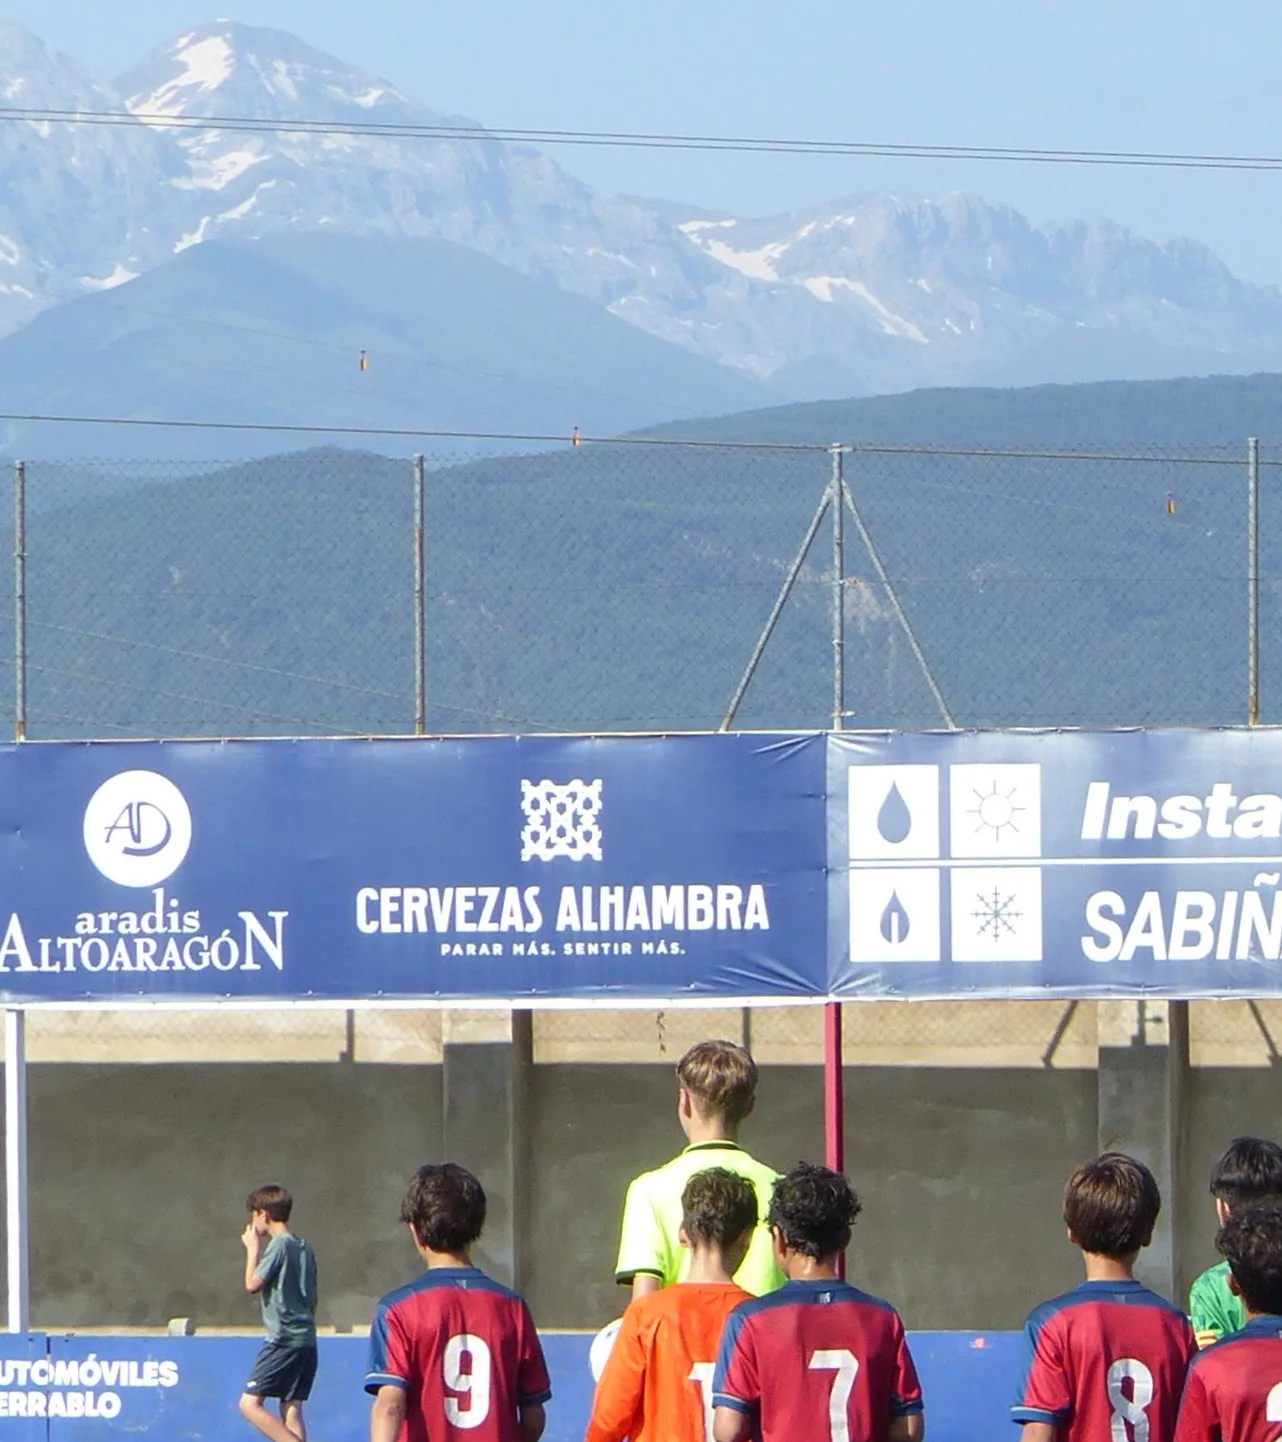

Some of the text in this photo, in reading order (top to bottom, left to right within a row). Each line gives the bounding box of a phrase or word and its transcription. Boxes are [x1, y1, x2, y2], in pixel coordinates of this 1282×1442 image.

[75, 887, 200, 934] aradis
[356, 884, 770, 934] CERVEZAS ALHAMBRA
[441, 939, 685, 956] PARAR MÁS. SENTIR MÁS.
[442, 1332, 491, 1429] 9
